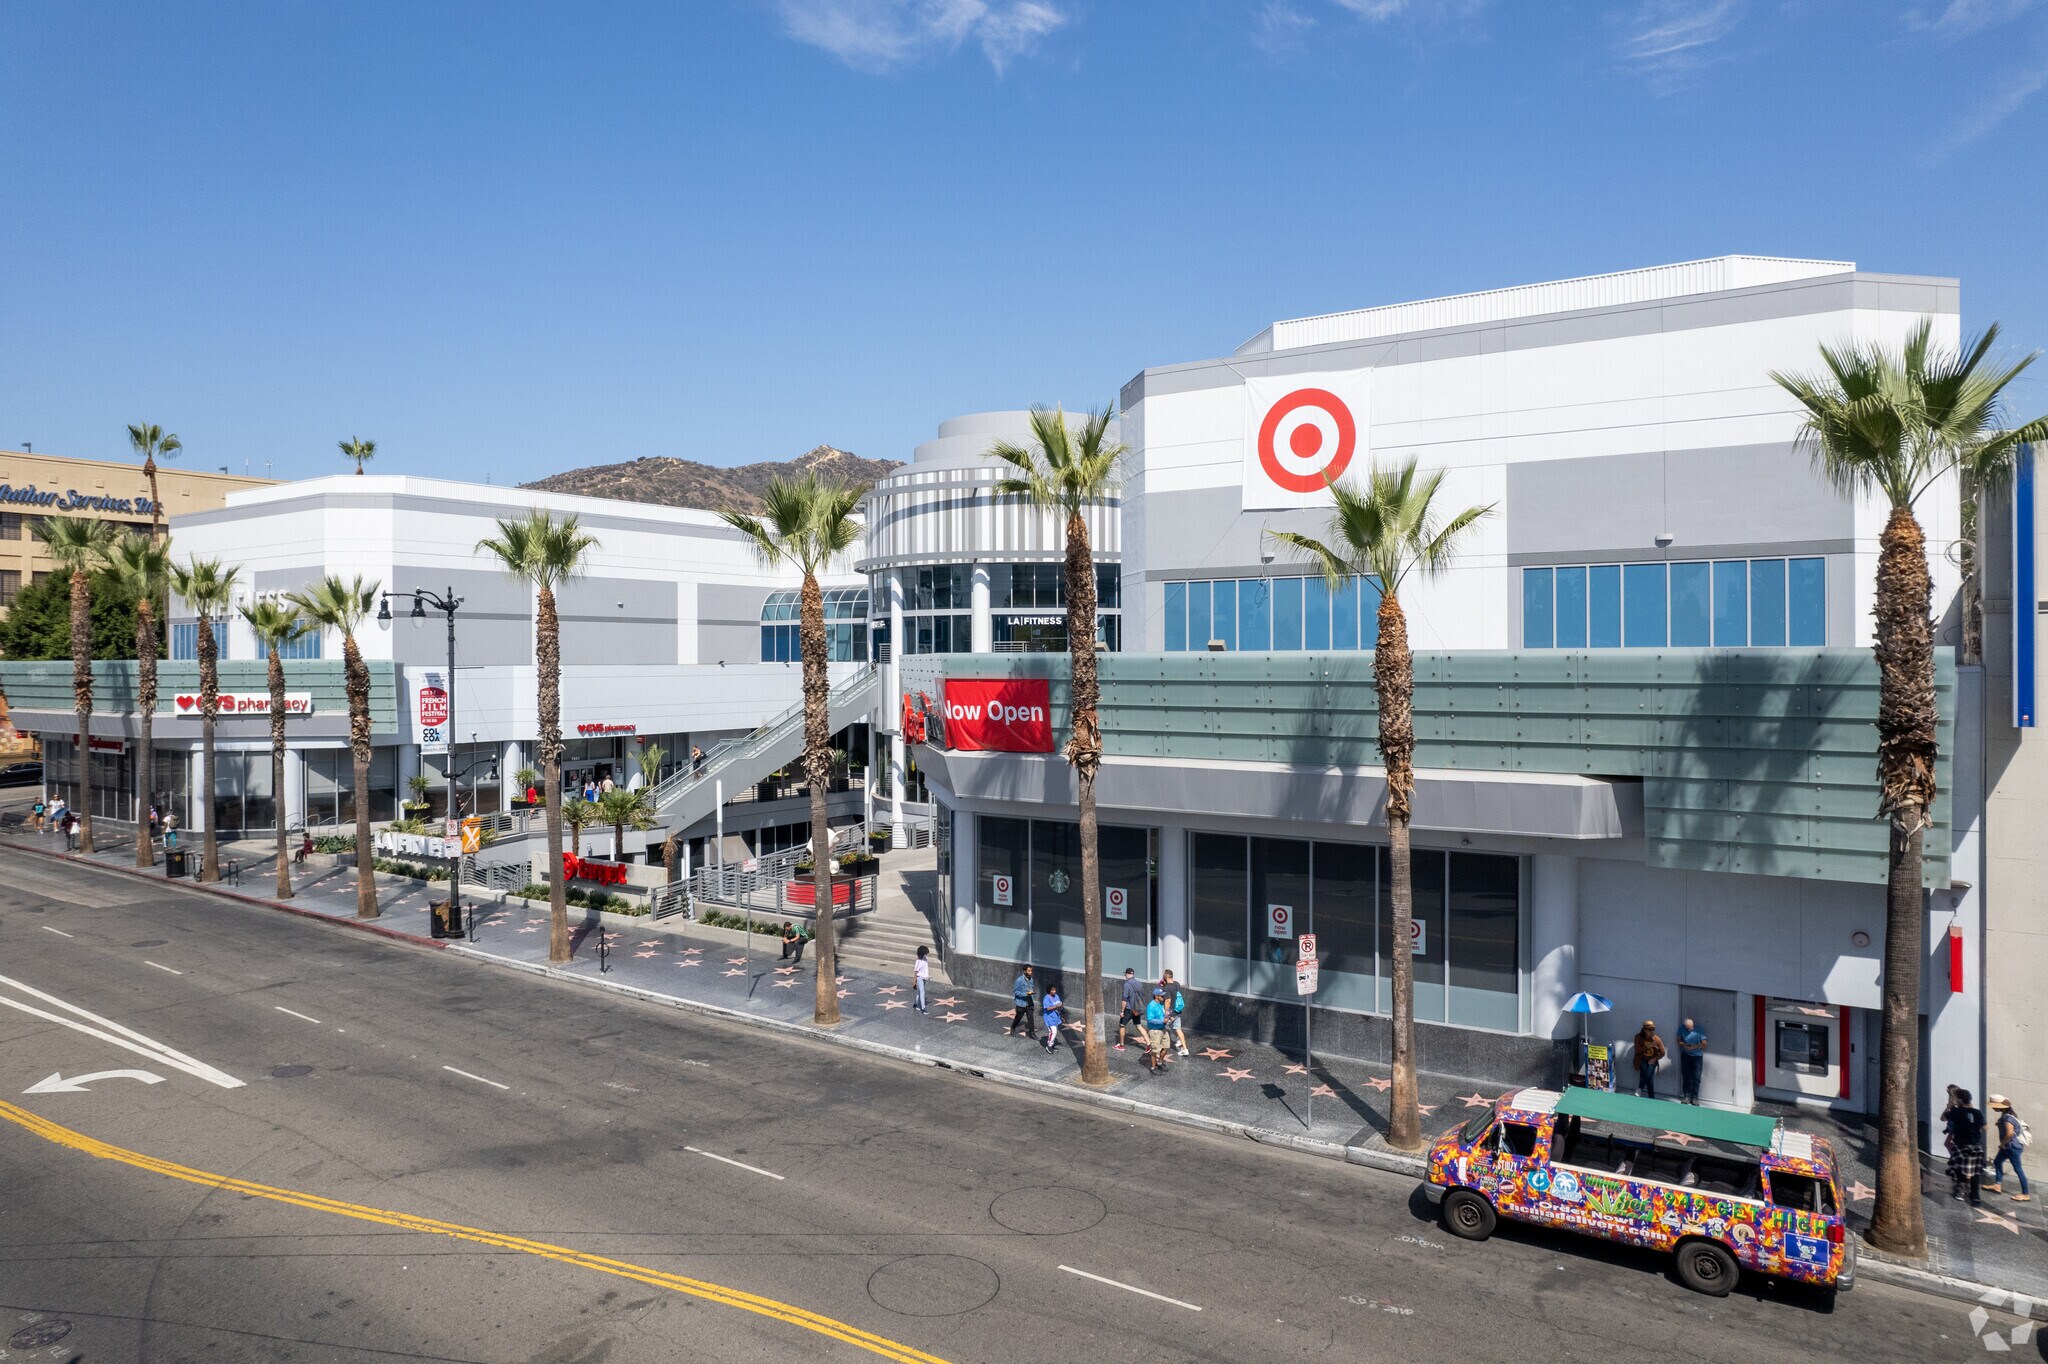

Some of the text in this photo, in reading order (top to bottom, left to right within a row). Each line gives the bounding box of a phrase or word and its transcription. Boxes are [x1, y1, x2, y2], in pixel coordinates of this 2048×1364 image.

[134, 497, 158, 513] In
[238, 697, 308, 712] pharacy
[987, 700, 1044, 725] Open
[423, 728, 439, 736] COL
[586, 723, 636, 733] CVS pharmacy
[1539, 1201, 1586, 1217] Order
[1591, 1209, 1634, 1226] Now!
[1664, 1192, 1827, 1236] 949 GET HIGH
